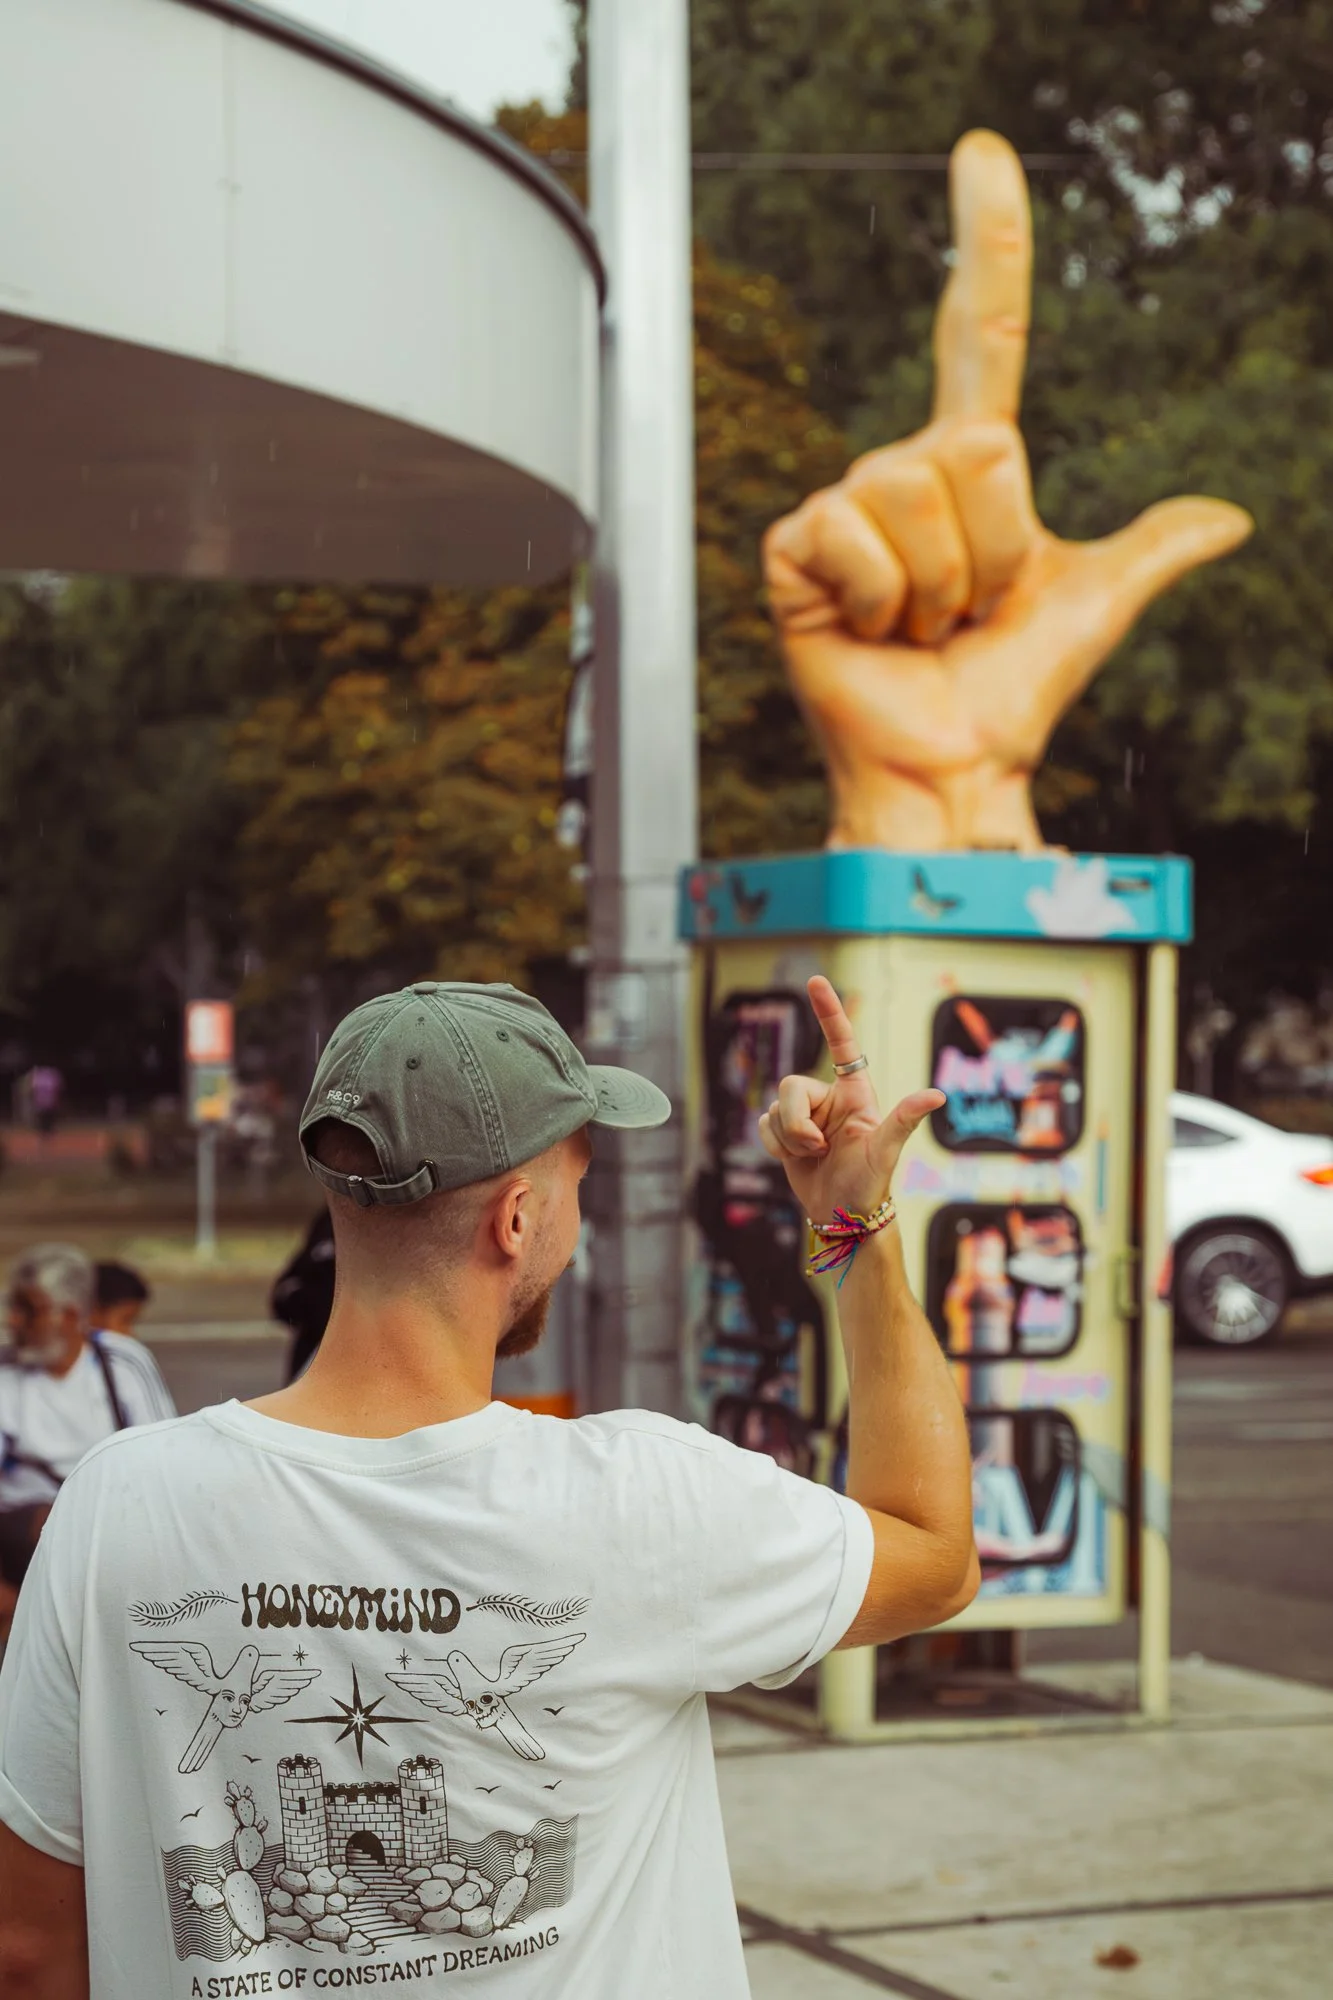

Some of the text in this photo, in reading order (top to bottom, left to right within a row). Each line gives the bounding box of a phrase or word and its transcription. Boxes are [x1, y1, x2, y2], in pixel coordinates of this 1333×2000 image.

[191, 1926, 560, 1999] A STATE OF CONSTANT DREAMING
